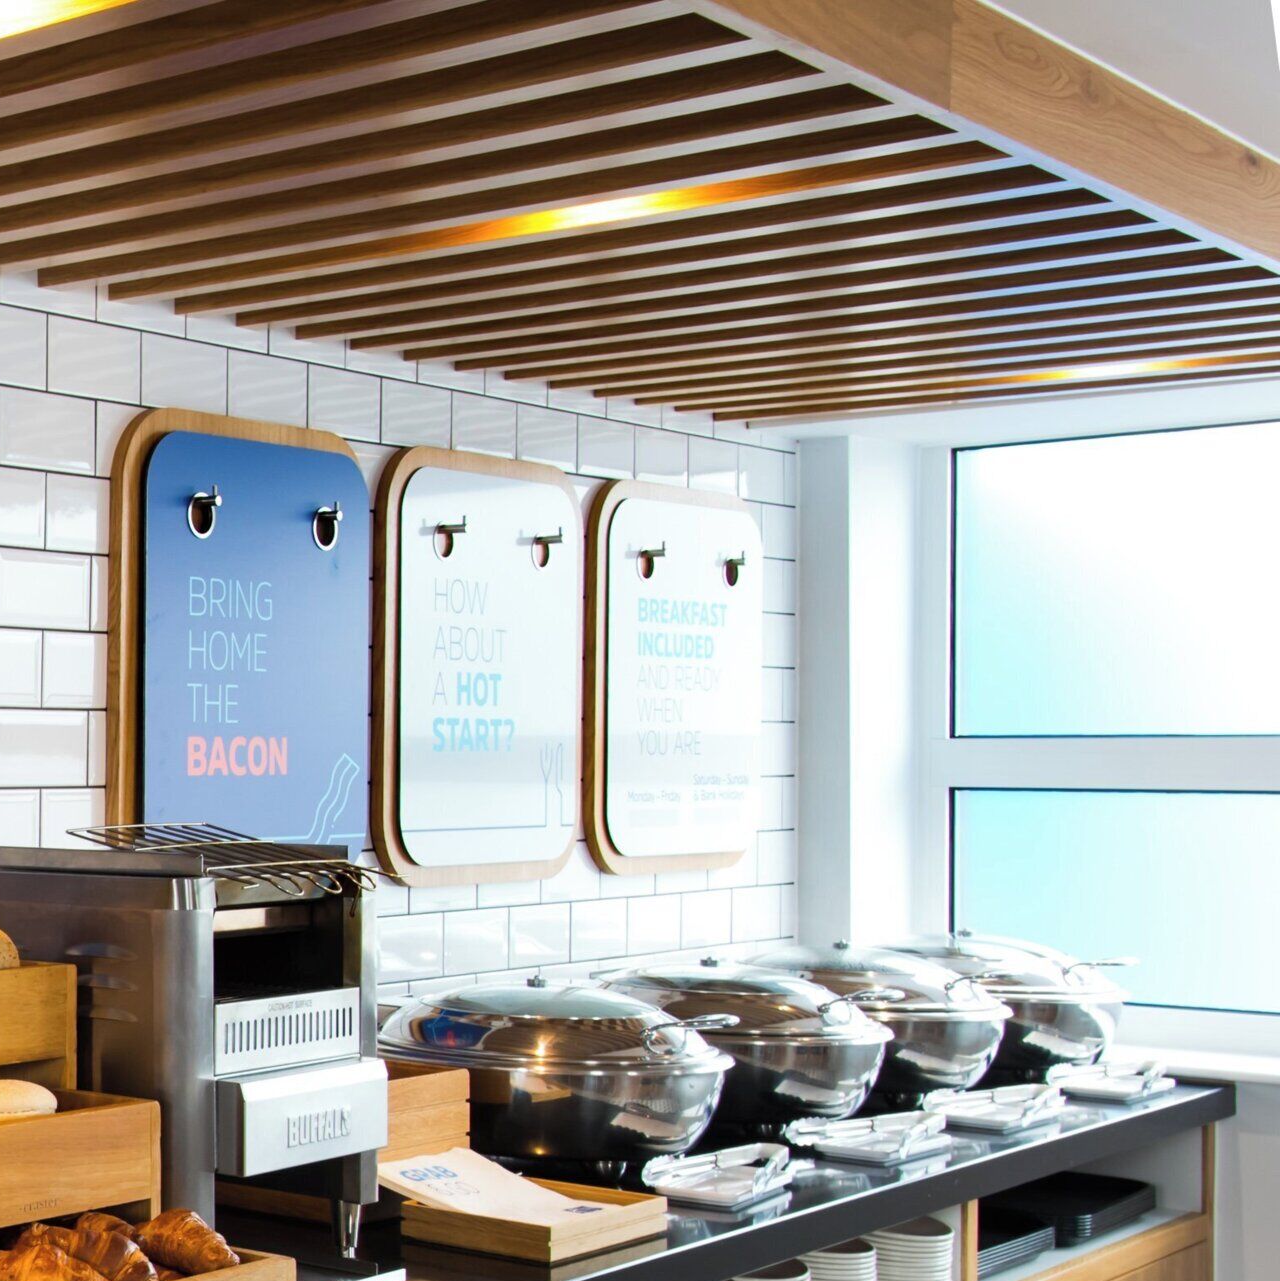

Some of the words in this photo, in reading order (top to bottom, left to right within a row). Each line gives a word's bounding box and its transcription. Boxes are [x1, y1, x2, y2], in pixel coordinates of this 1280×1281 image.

[188, 575, 273, 621] BRING
[432, 577, 489, 616] HOW
[637, 597, 728, 628] BREAKFAST
[187, 629, 268, 673] HOME
[432, 626, 507, 663] ABOUT
[637, 632, 715, 660] INCLUDED
[432, 671, 448, 707] A
[455, 672, 503, 707] HOT
[636, 665, 668, 690] AND
[674, 667, 721, 693] READY
[186, 683, 240, 724] THE
[636, 697, 683, 724] WHEN
[432, 717, 516, 752] START?
[636, 729, 668, 756] YOU
[672, 730, 702, 757] ARE
[186, 735, 288, 777] BACON
